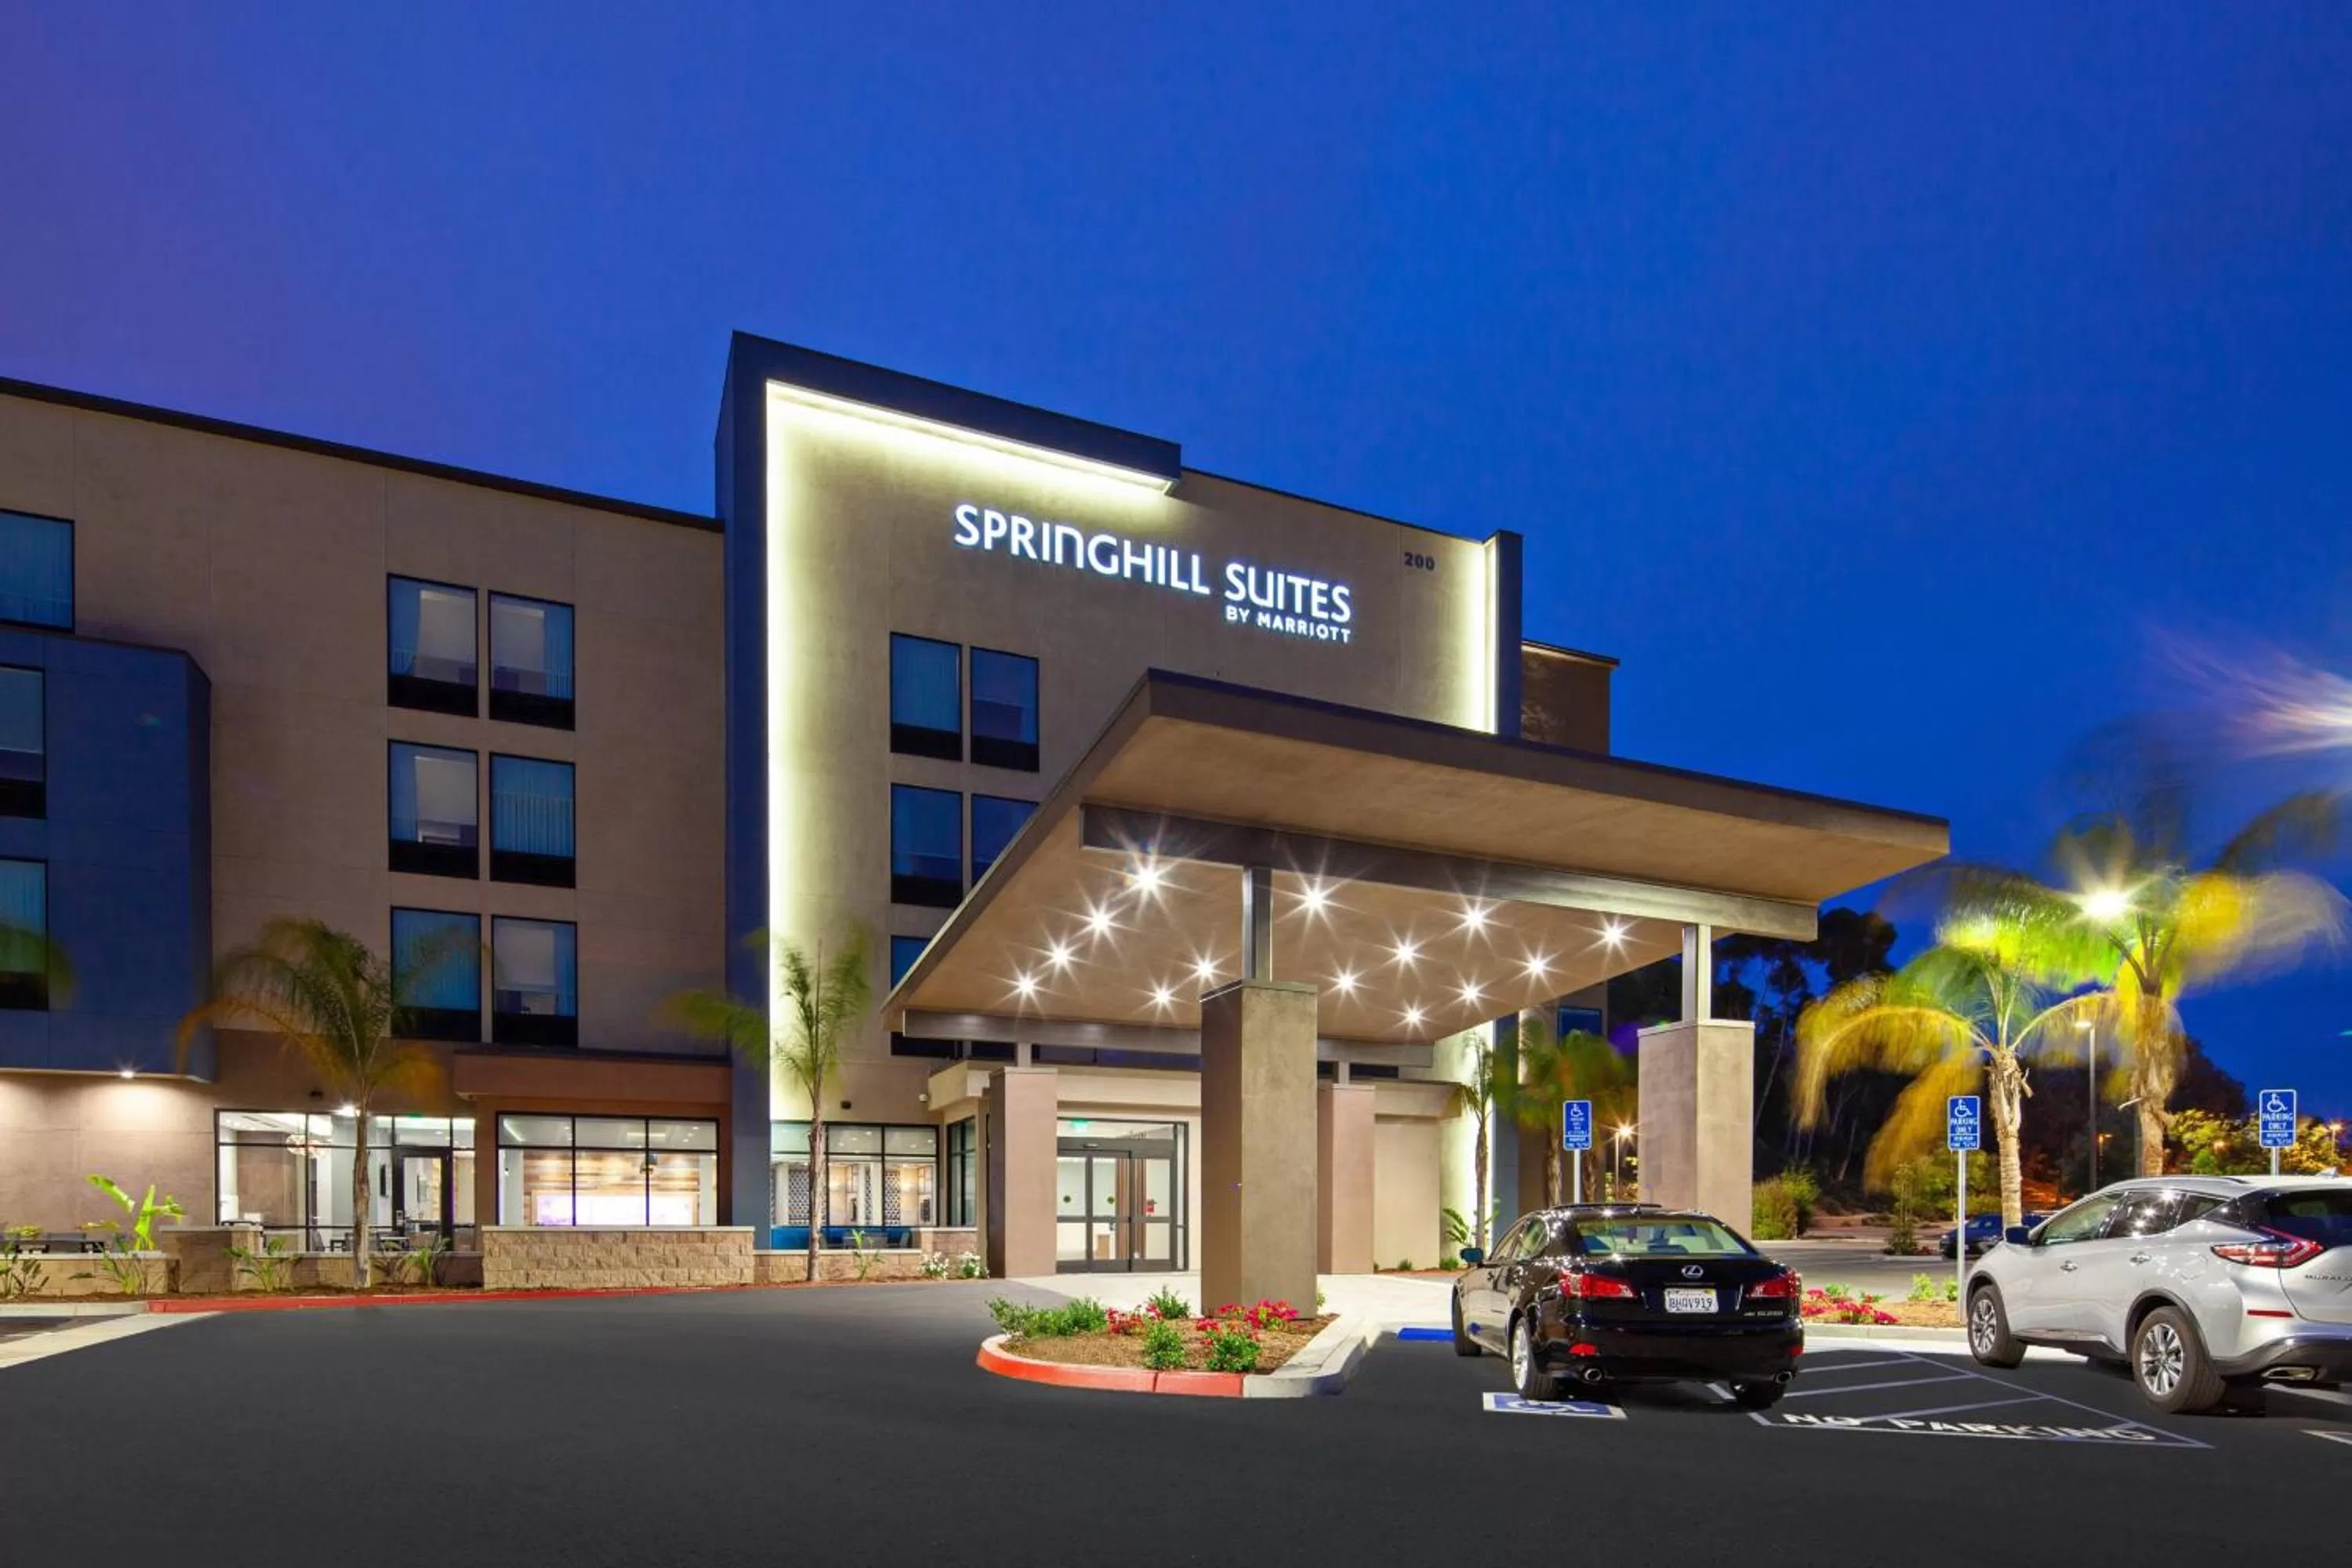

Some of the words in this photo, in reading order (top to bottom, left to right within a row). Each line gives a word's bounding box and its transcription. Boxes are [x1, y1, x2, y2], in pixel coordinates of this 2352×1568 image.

[1404, 551, 1436, 572] 200
[1224, 563, 1351, 622] SUITES
[1225, 605, 1250, 623] BY
[1257, 612, 1351, 643] MARRIOTT
[1782, 1414, 1861, 1426] NO
[1887, 1417, 2155, 1441] PARKING
